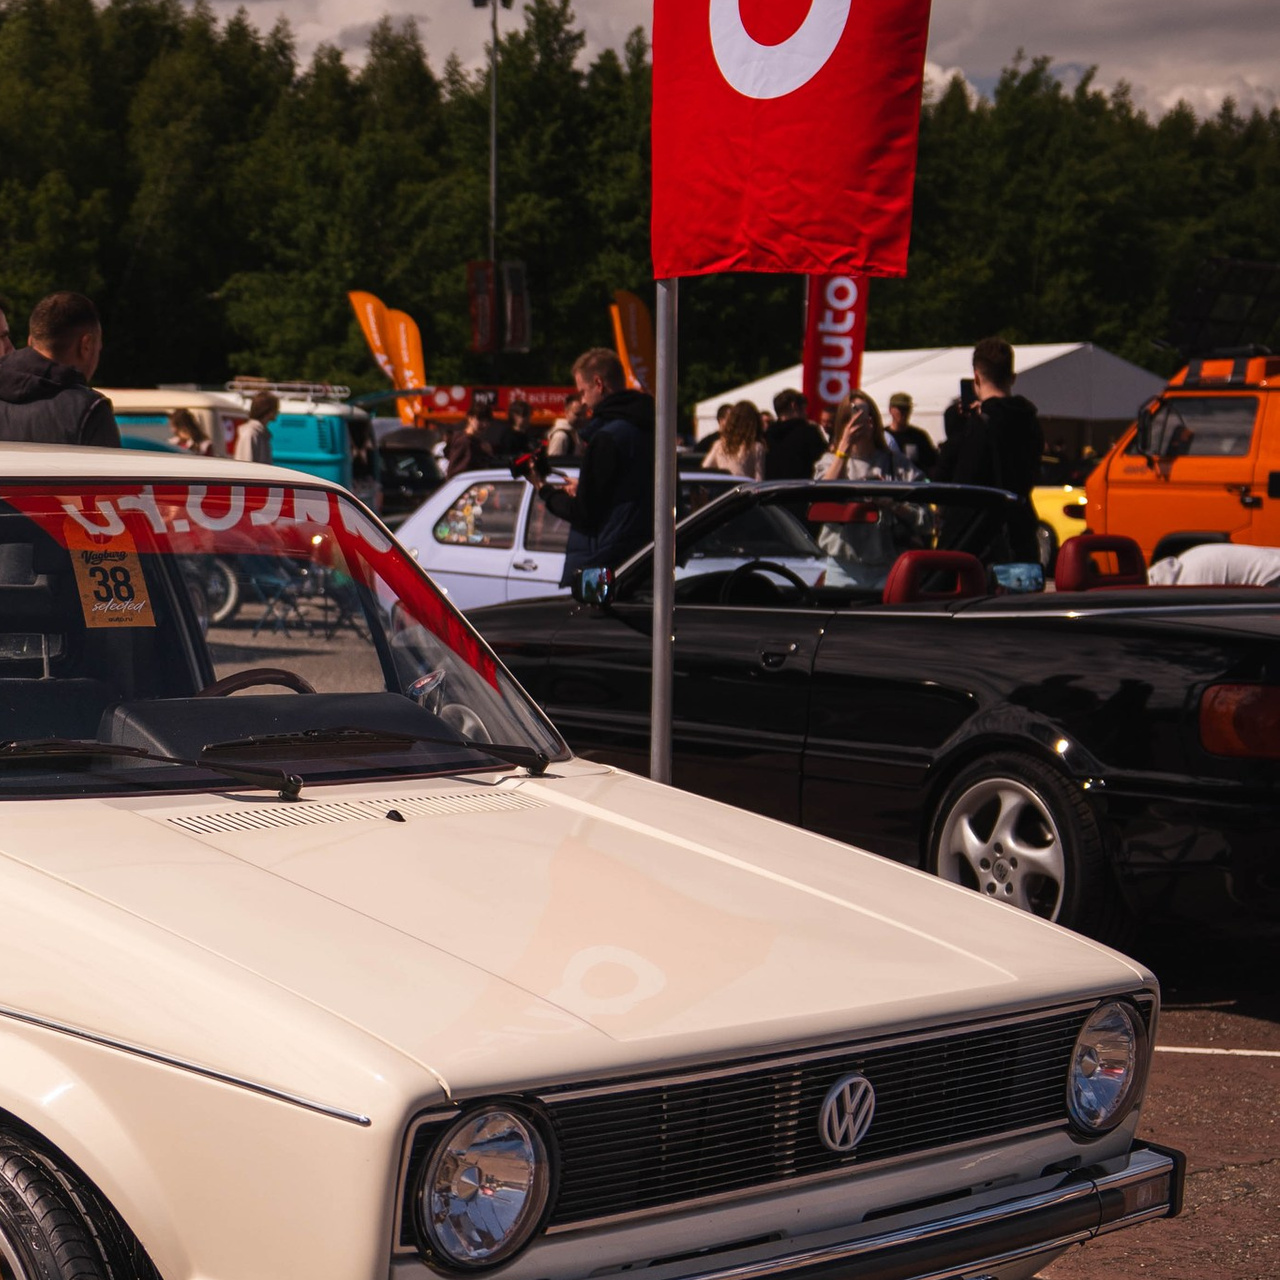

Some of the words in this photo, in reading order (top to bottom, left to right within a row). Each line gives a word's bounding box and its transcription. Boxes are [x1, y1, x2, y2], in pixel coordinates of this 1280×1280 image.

[81, 550, 128, 566] Vagburg
[89, 566, 135, 602] 38
[91, 598, 146, 613] selected
